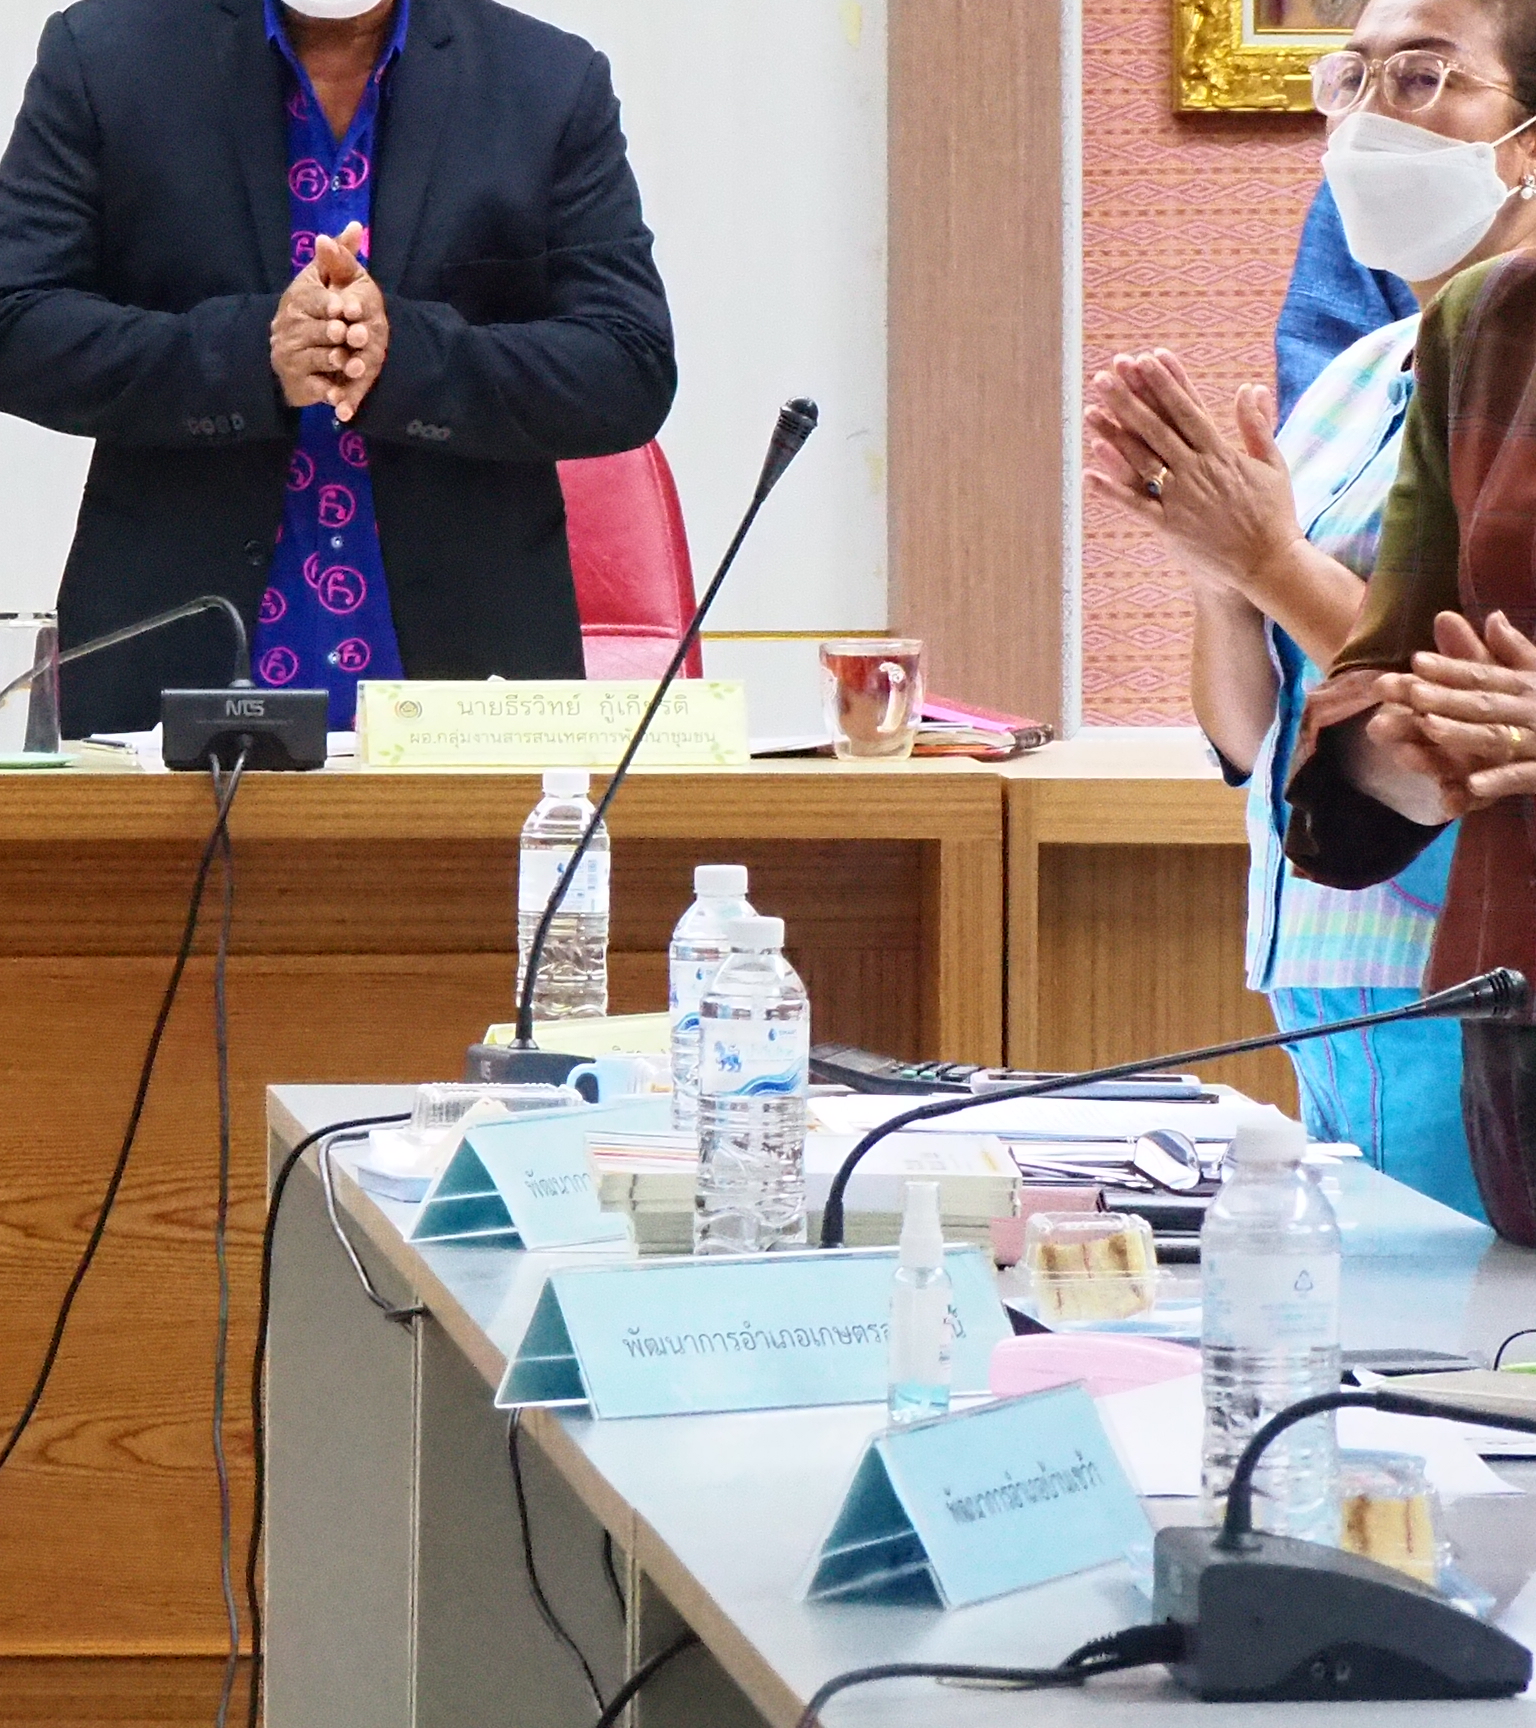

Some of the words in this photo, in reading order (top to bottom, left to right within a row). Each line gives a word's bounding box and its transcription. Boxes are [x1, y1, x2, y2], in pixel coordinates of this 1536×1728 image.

[457, 693, 582, 717] นายธีรวิทย์
[410, 727, 717, 749] ผอ.กลุ่มงานสารสนเทศการพันาชุมชน
